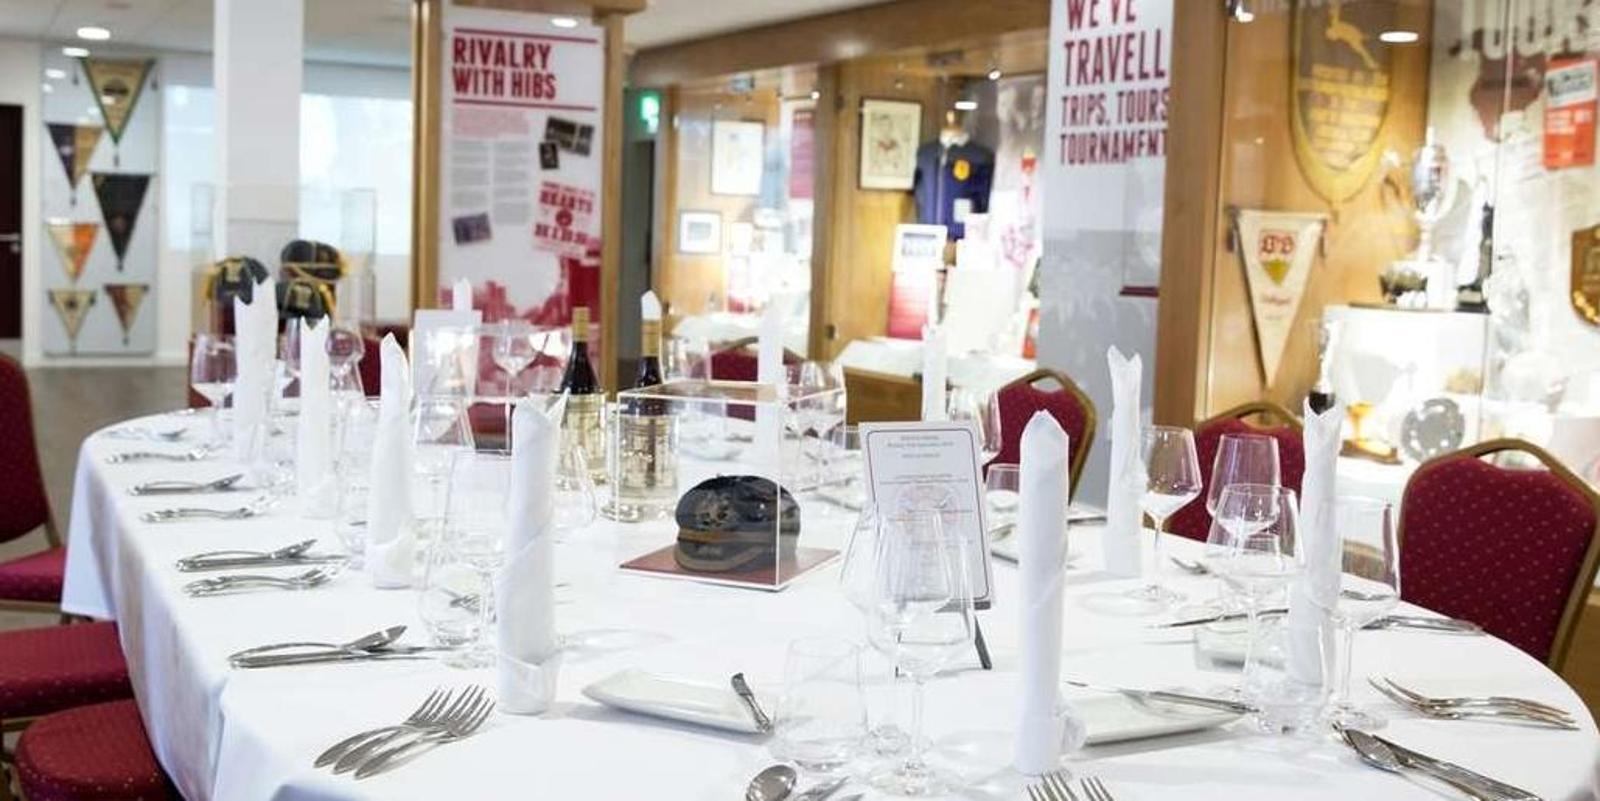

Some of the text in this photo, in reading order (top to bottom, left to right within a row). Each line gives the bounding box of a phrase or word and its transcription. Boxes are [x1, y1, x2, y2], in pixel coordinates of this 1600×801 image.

[453, 36, 551, 69] RIVALRY
[452, 66, 557, 100] WITH HIBS
